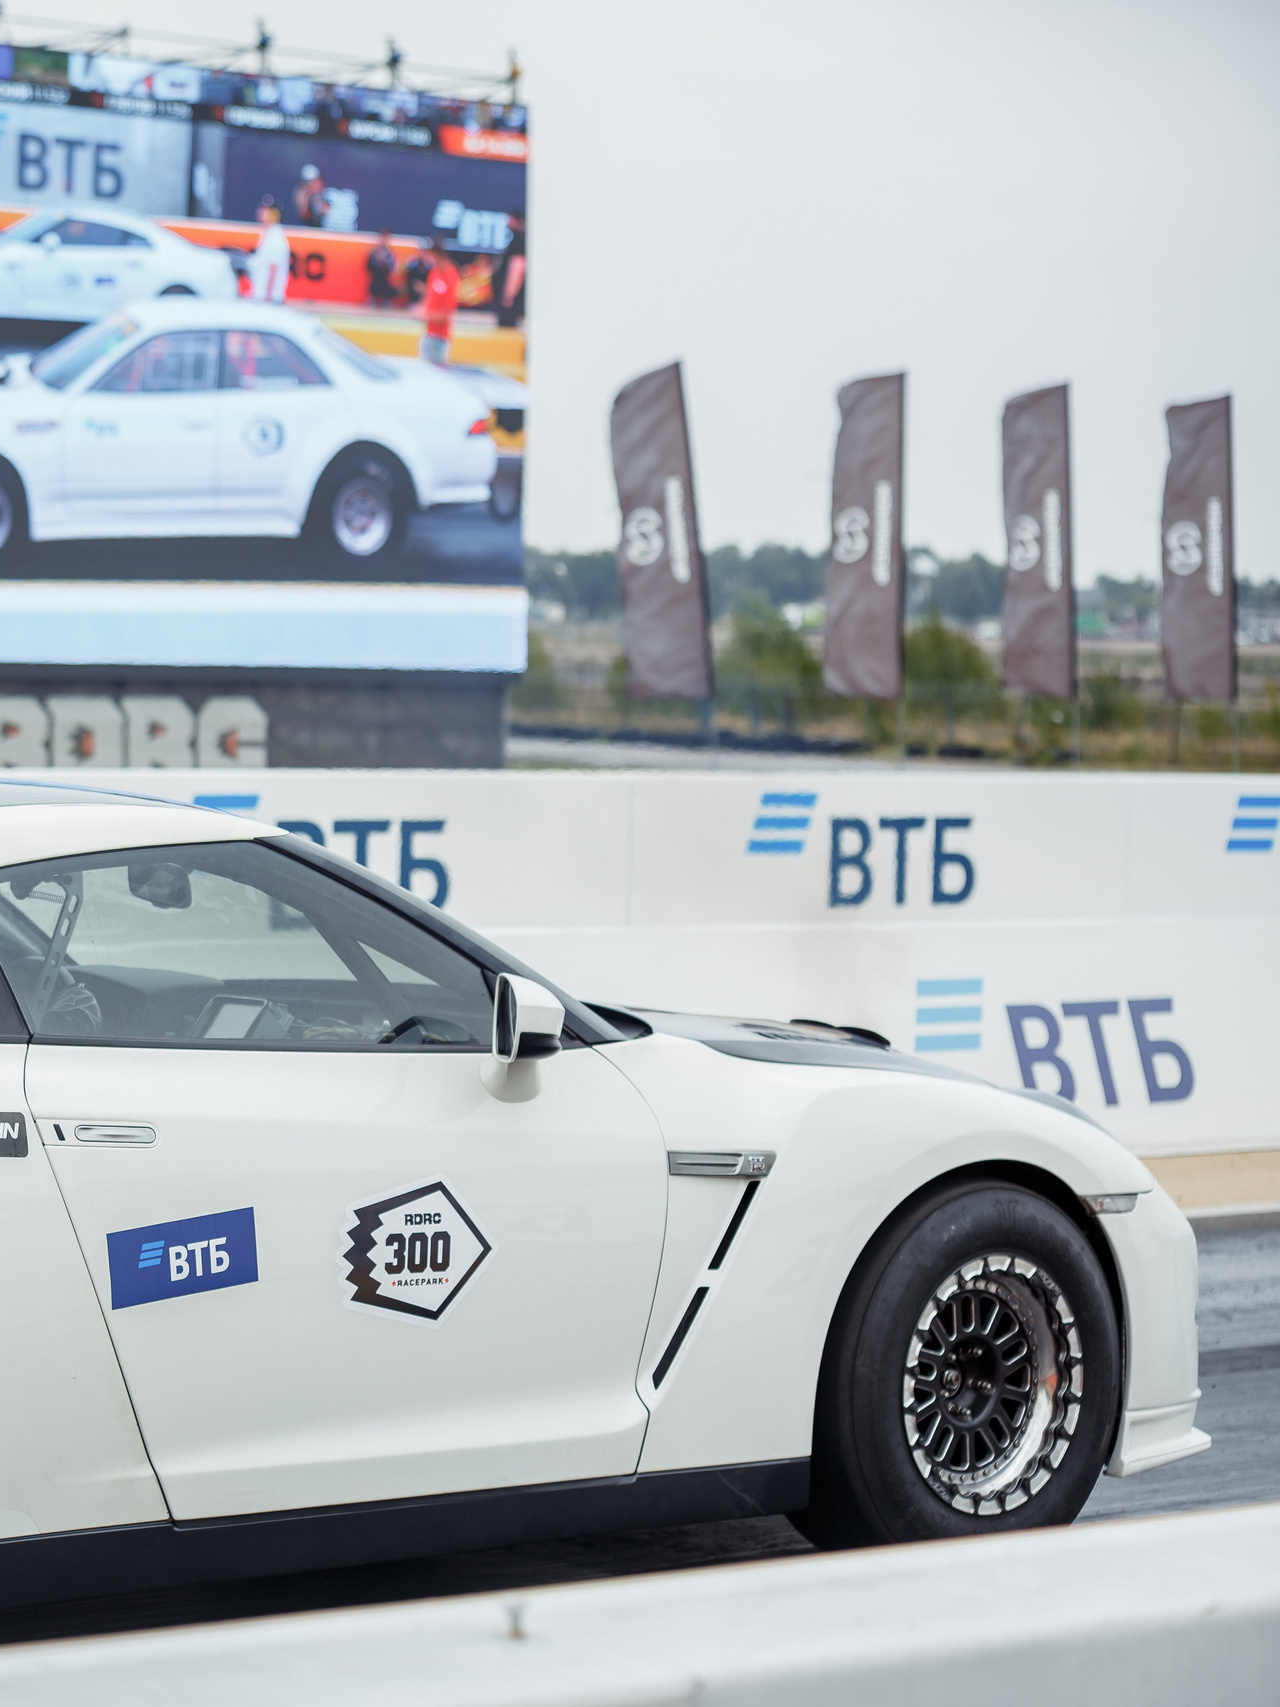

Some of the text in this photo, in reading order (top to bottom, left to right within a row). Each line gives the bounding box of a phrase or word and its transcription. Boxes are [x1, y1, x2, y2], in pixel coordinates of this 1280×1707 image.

[17, 132, 125, 199] ВТБ
[828, 816, 976, 908] ВТБ
[1006, 997, 1194, 1107] ВТБ
[404, 1212, 442, 1227] RDRC
[168, 1236, 231, 1282] ВТБ
[384, 1231, 451, 1275] 300
[397, 1276, 444, 1288] RACEPARK
